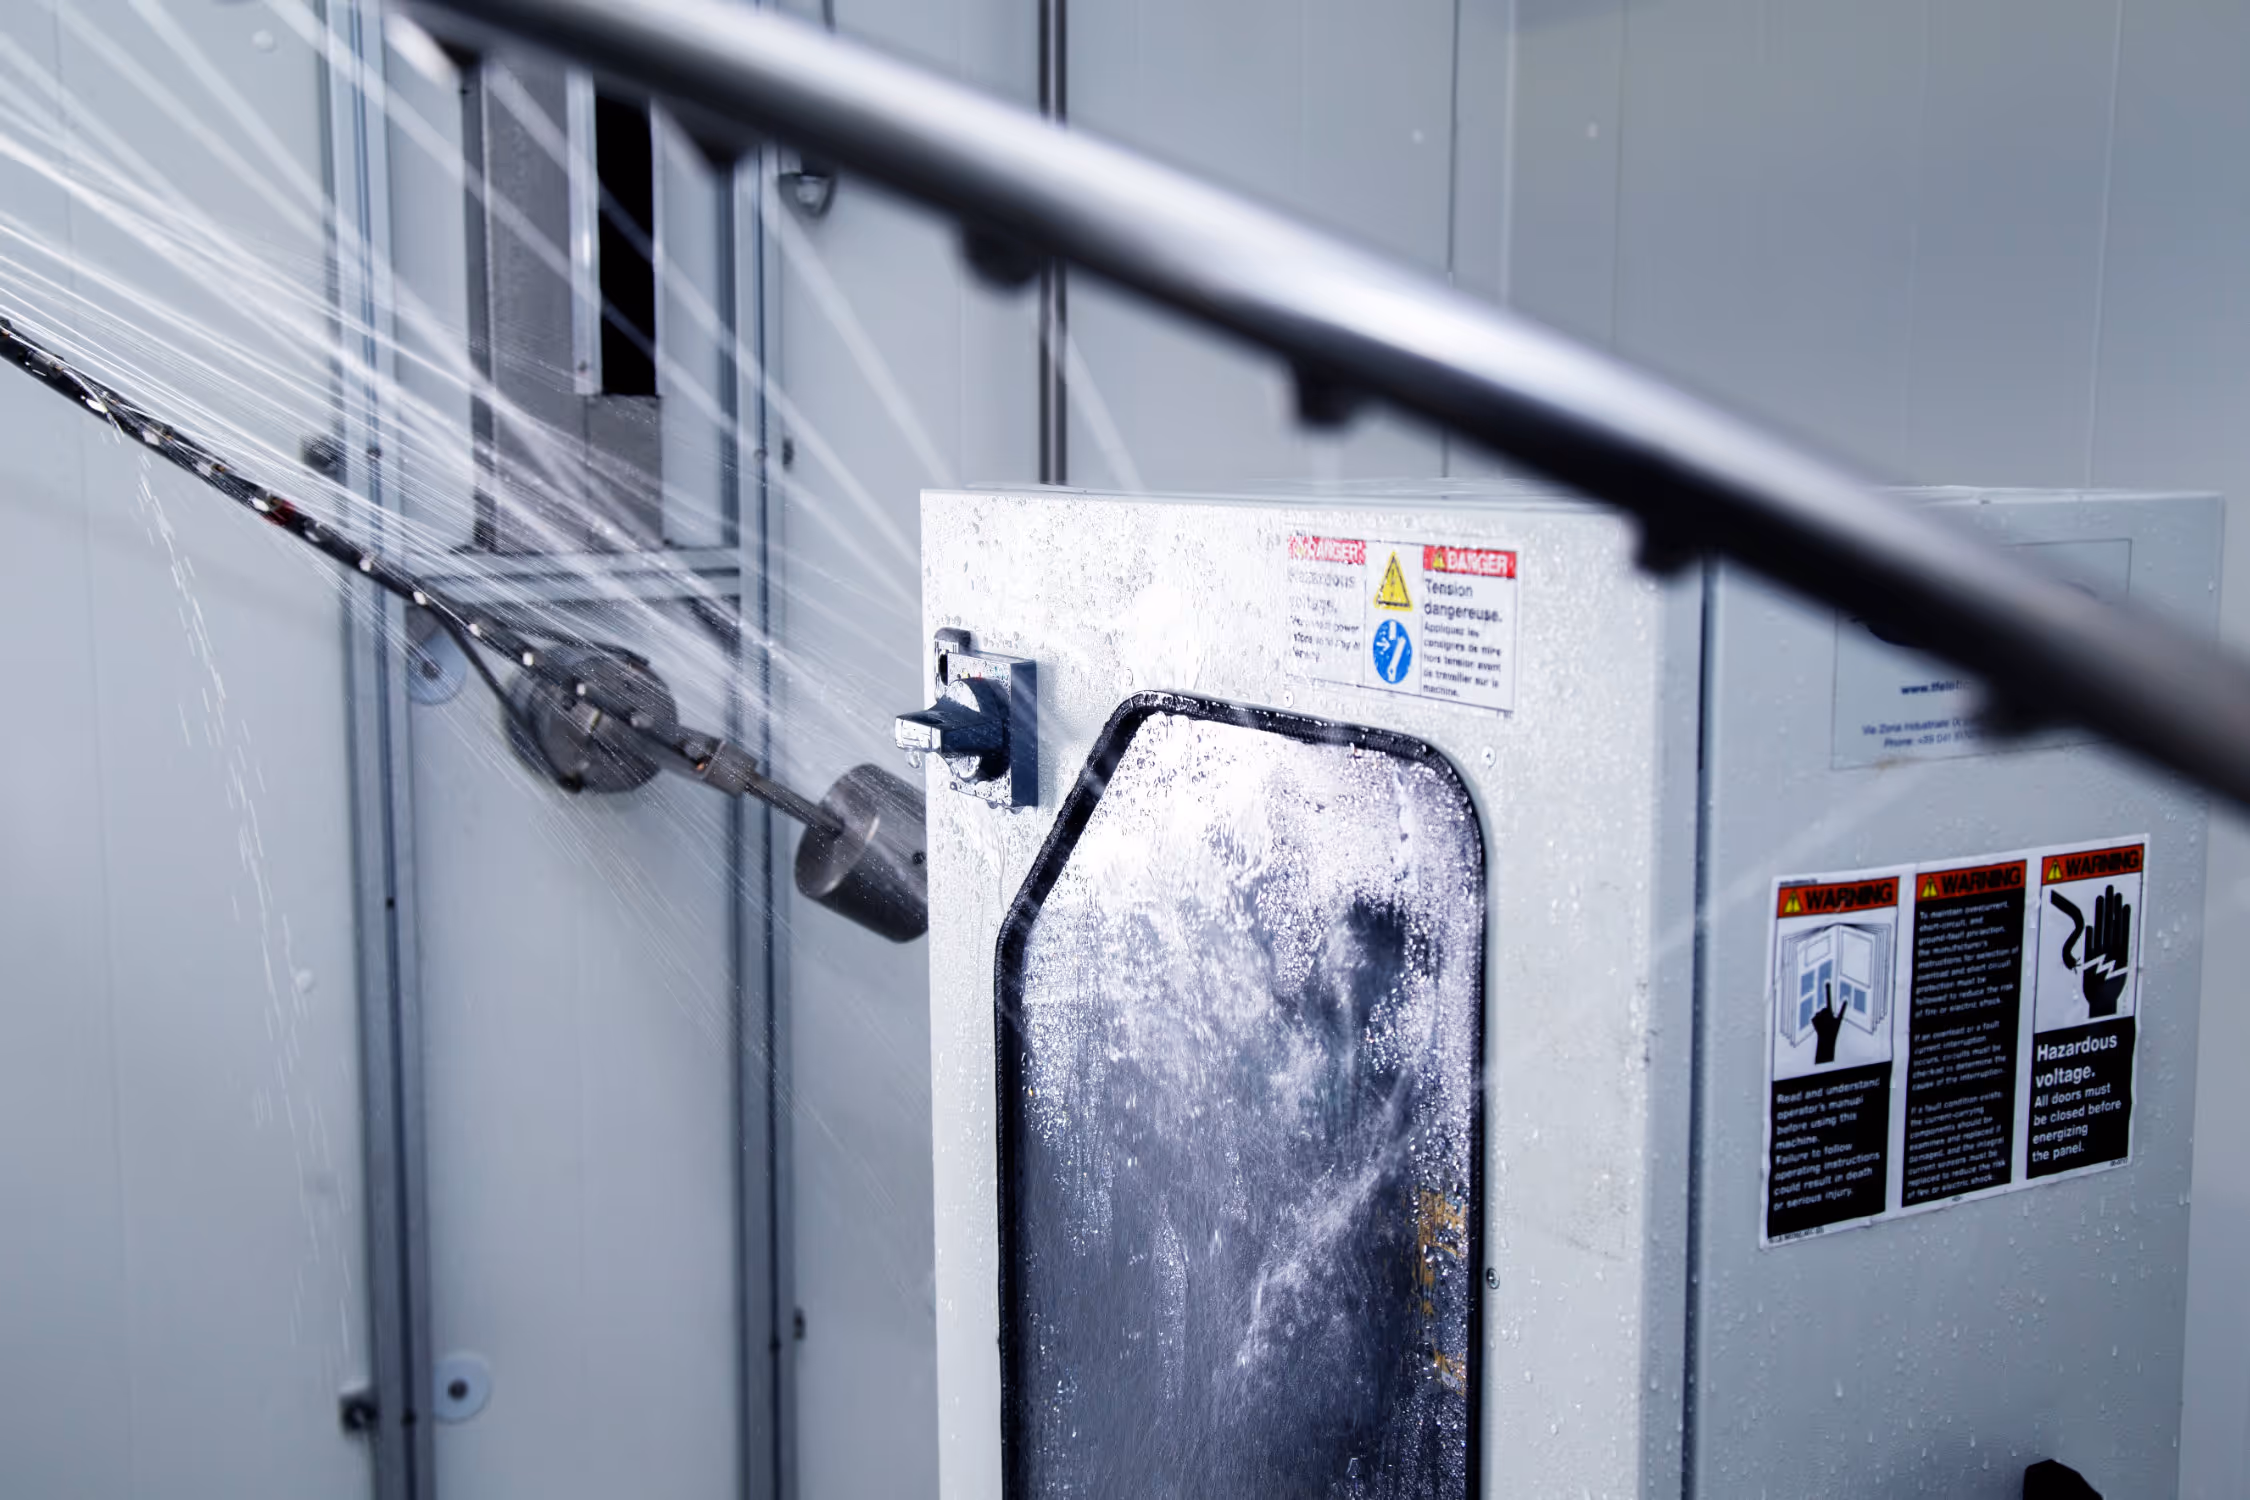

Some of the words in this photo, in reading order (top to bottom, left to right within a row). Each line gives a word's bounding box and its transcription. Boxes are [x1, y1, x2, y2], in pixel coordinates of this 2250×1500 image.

[1447, 551, 1507, 574] DANGER
[1425, 578, 1473, 598] Tension
[1424, 602, 1502, 622] dangereuse.
[2066, 850, 2140, 877] WARNING
[1941, 866, 2021, 894] WARNING
[1805, 883, 1893, 911] WARNING
[1914, 1043, 1941, 1055] current
[1943, 1035, 1987, 1048] interruption
[2037, 1034, 2118, 1062] Hazardous
[2036, 1065, 2095, 1088] voltage.
[1777, 1092, 1802, 1104] Read
[1805, 1088, 1823, 1100] and
[1826, 1077, 1880, 1095] understand
[2034, 1095, 2049, 1108] All
[2052, 1089, 2081, 1104] doors
[2085, 1082, 2111, 1098] must
[1777, 1103, 1826, 1120] operator's
[1829, 1096, 1863, 1109] manual
[2033, 1114, 2047, 1127] be
[2050, 1104, 2085, 1123] closed
[2088, 1100, 2122, 1115] before
[1776, 1121, 1807, 1135] before
[1811, 1116, 1836, 1128] using
[1840, 1112, 1857, 1122] this
[2032, 1124, 2088, 1144] energizing
[1776, 1136, 1820, 1149] machine.
[1776, 1152, 1808, 1165] Failure
[1824, 1143, 1853, 1155] follow
[2032, 1150, 2049, 1162] the
[2052, 1141, 2085, 1160] panel.
[1775, 1164, 1821, 1180] operating
[1824, 1152, 1880, 1169] instructions
[1774, 1182, 1800, 1196] could
[1804, 1176, 1831, 1189] result
[1846, 1167, 1873, 1180] death
[1773, 1202, 1783, 1211] or
[1787, 1195, 1822, 1208] serious
[1825, 1187, 1853, 1200] injury.
